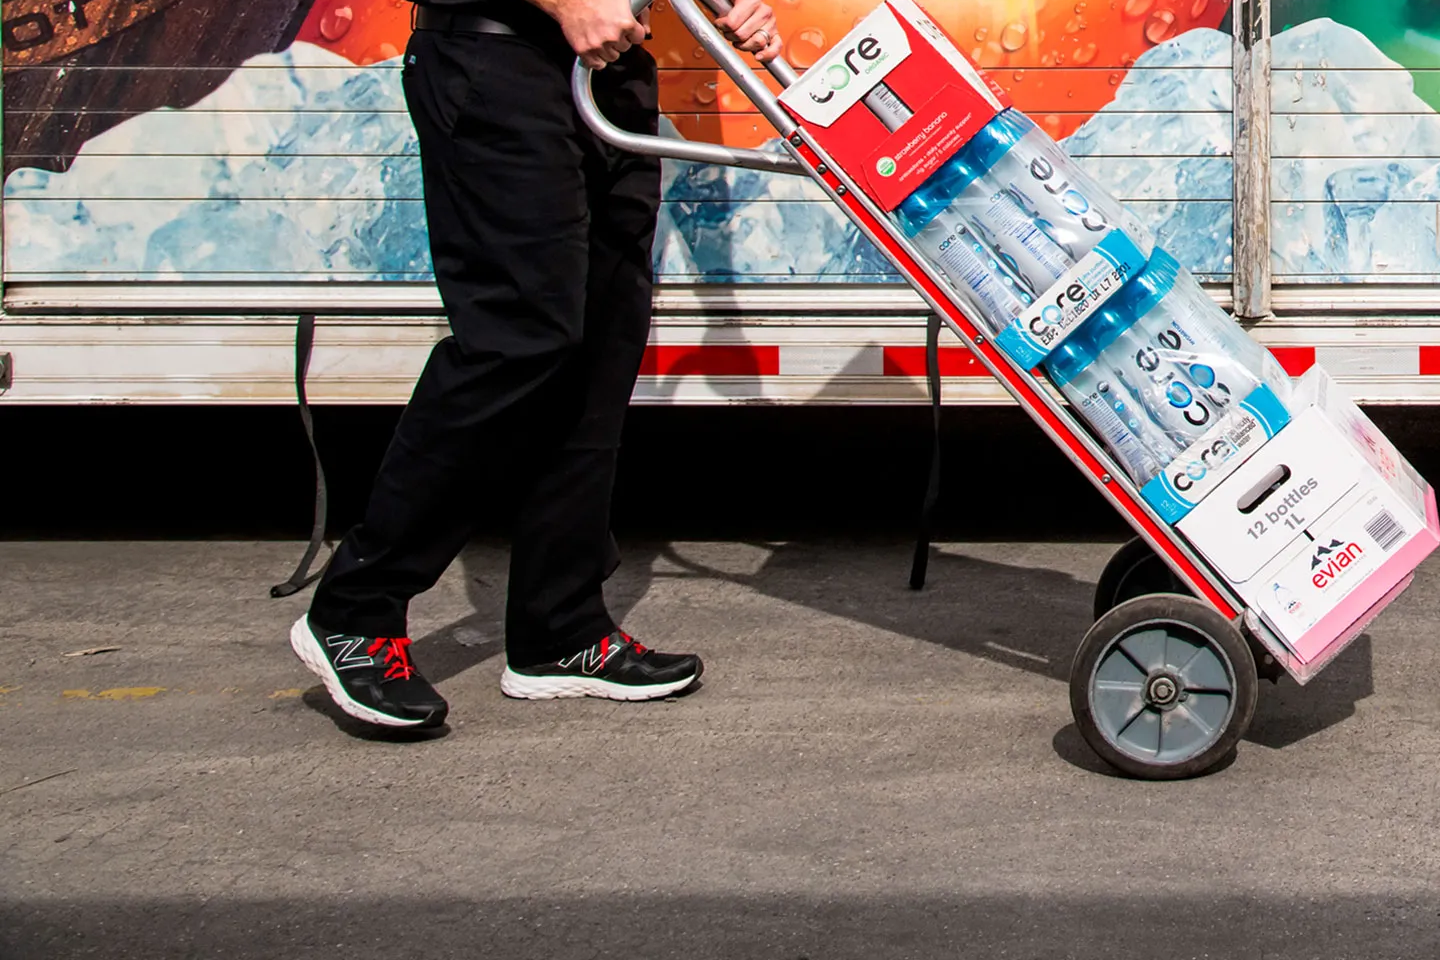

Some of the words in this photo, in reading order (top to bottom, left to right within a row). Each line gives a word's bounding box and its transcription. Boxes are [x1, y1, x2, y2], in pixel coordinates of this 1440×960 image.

[809, 37, 881, 104] core
[894, 132, 926, 161] strawberry
[922, 112, 947, 133] banana
[1030, 156, 1108, 232] core
[939, 234, 956, 251] core
[1100, 278, 1112, 291] L7
[1111, 262, 1131, 281] 2201
[1029, 283, 1085, 336] core
[1173, 440, 1230, 491] core
[1247, 521, 1268, 539] 12
[1265, 478, 1318, 524] bottles
[1284, 513, 1305, 530] 1L
[1312, 543, 1362, 588] evian
